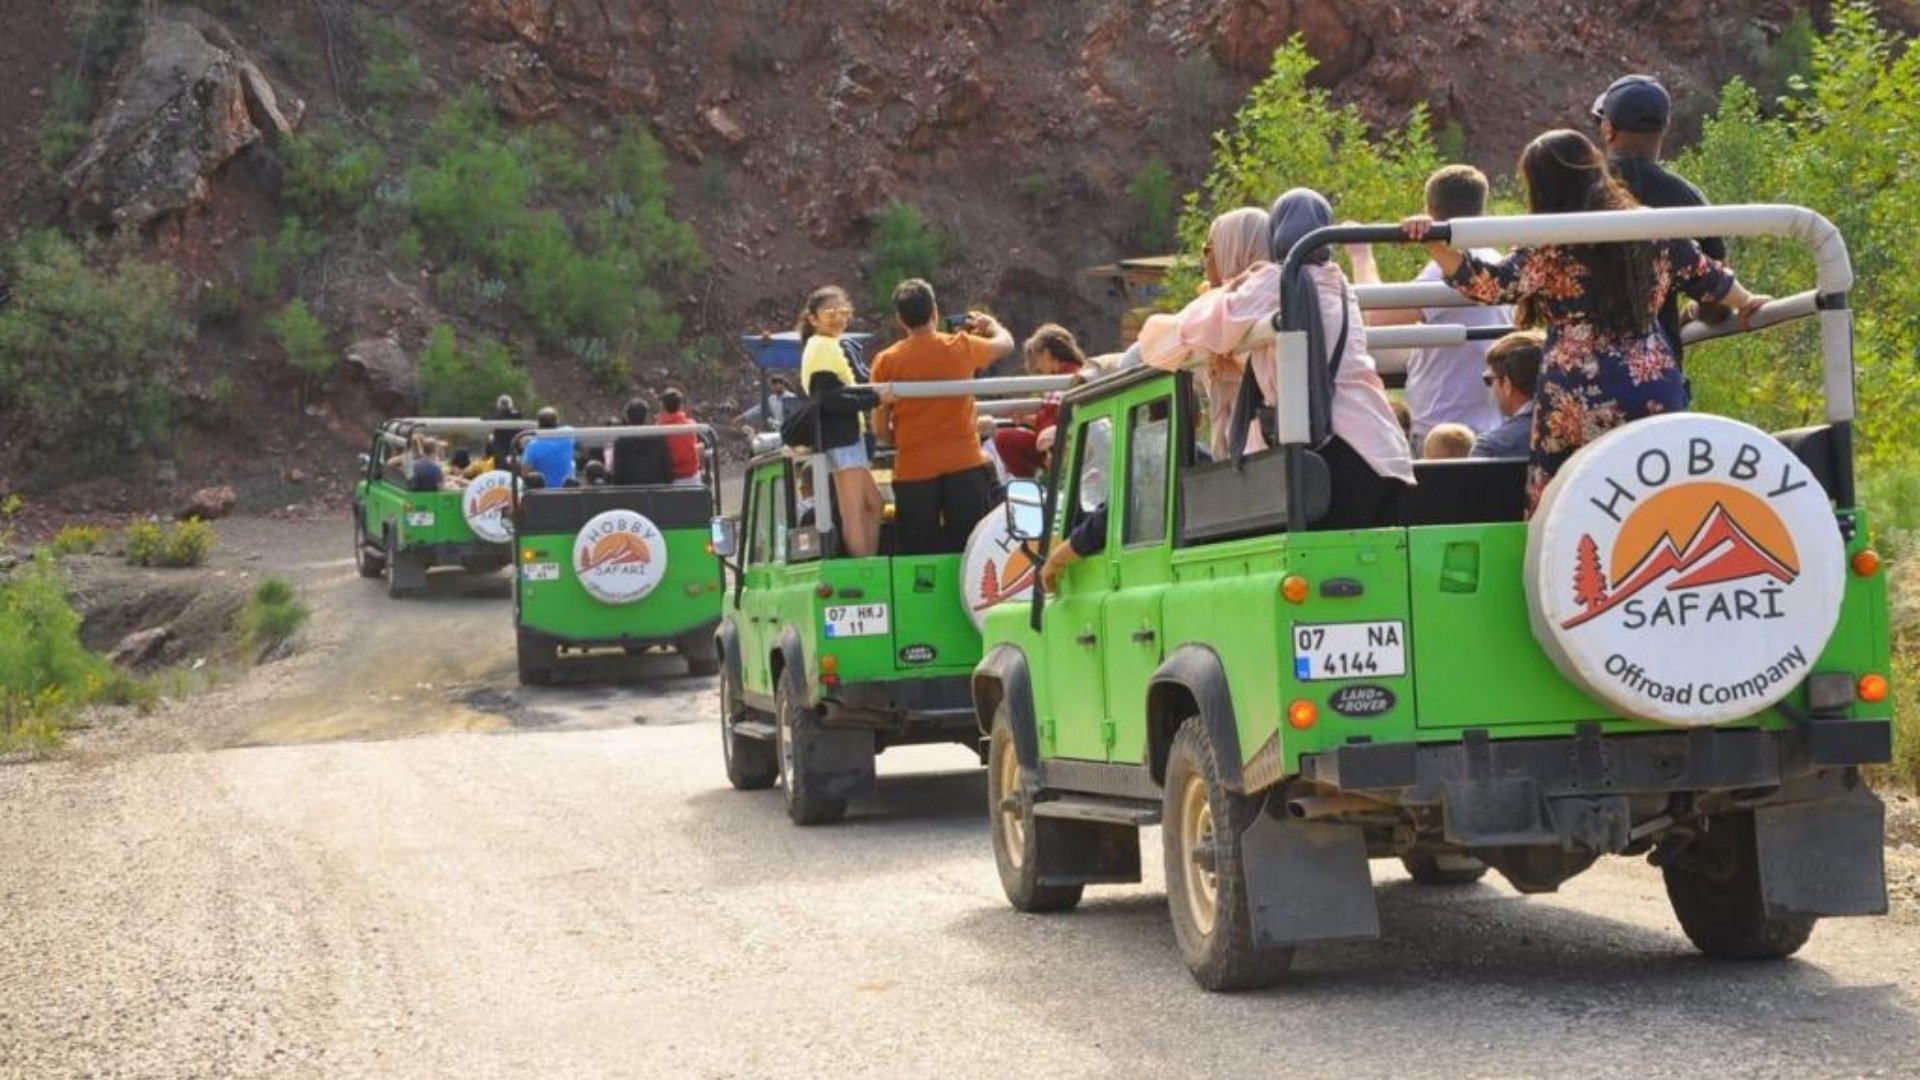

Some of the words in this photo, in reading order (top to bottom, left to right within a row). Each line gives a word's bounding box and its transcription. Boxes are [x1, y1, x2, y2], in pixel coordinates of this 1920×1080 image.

[1590, 438, 1808, 522] HOBBY
[588, 519, 655, 542] HOBBY
[829, 608, 846, 621] 07
[850, 620, 863, 634] 11
[1298, 628, 1325, 651] 07
[1367, 626, 1399, 647] NA
[1323, 652, 1377, 675] 4144
[1604, 653, 1692, 706] Offroad
[1699, 645, 1807, 705] Company
